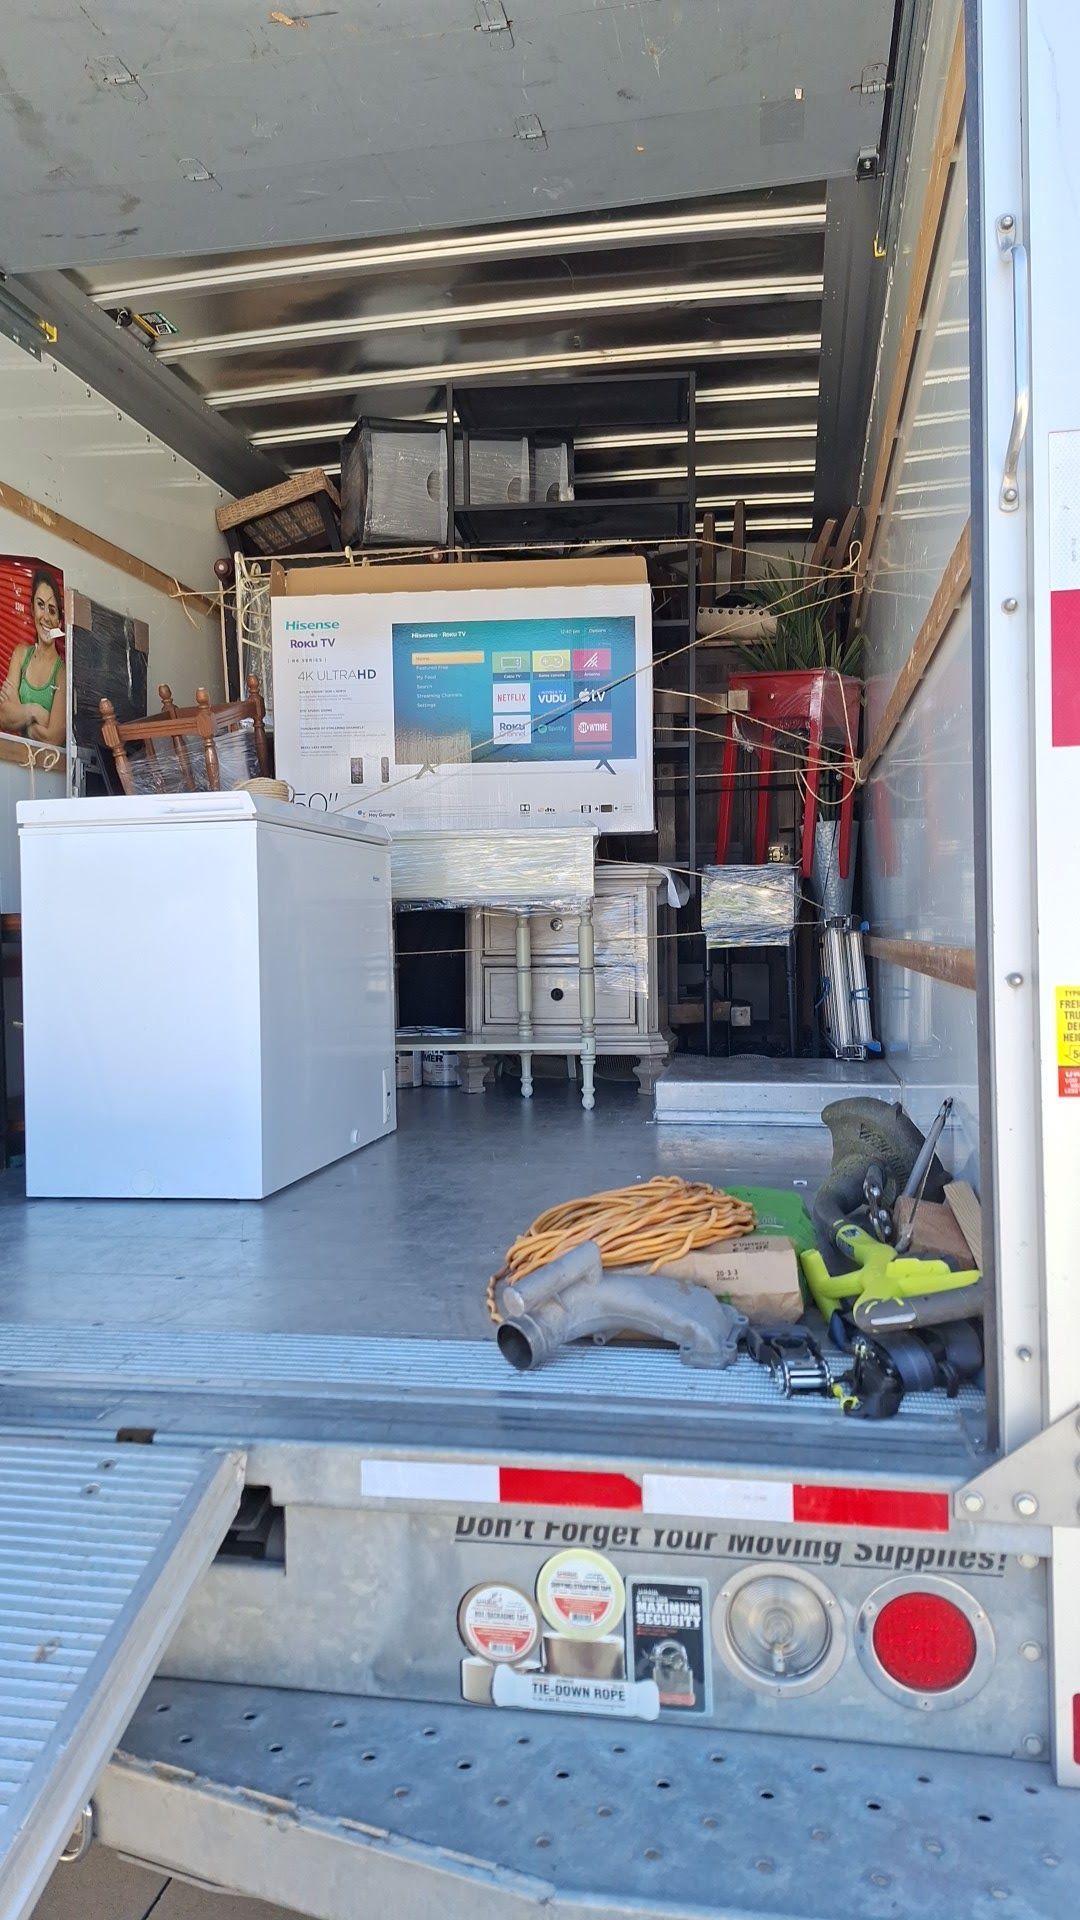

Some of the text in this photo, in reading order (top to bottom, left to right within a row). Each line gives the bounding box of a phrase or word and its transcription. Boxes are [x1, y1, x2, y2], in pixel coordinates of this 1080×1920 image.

[285, 620, 340, 630] Hisense
[290, 638, 336, 648] Roku TV
[297, 671, 314, 680] 4K
[497, 693, 526, 703] NETFLIX
[538, 693, 567, 704] VUDU
[499, 722, 526, 731] Roku
[455, 1515, 1008, 1573] Don't Forget Your Moving Supplies!
[636, 1600, 701, 1617] MAXIMUM
[636, 1613, 702, 1629] SECURITY
[532, 1683, 626, 1702] TIE-DOWN ROPE
